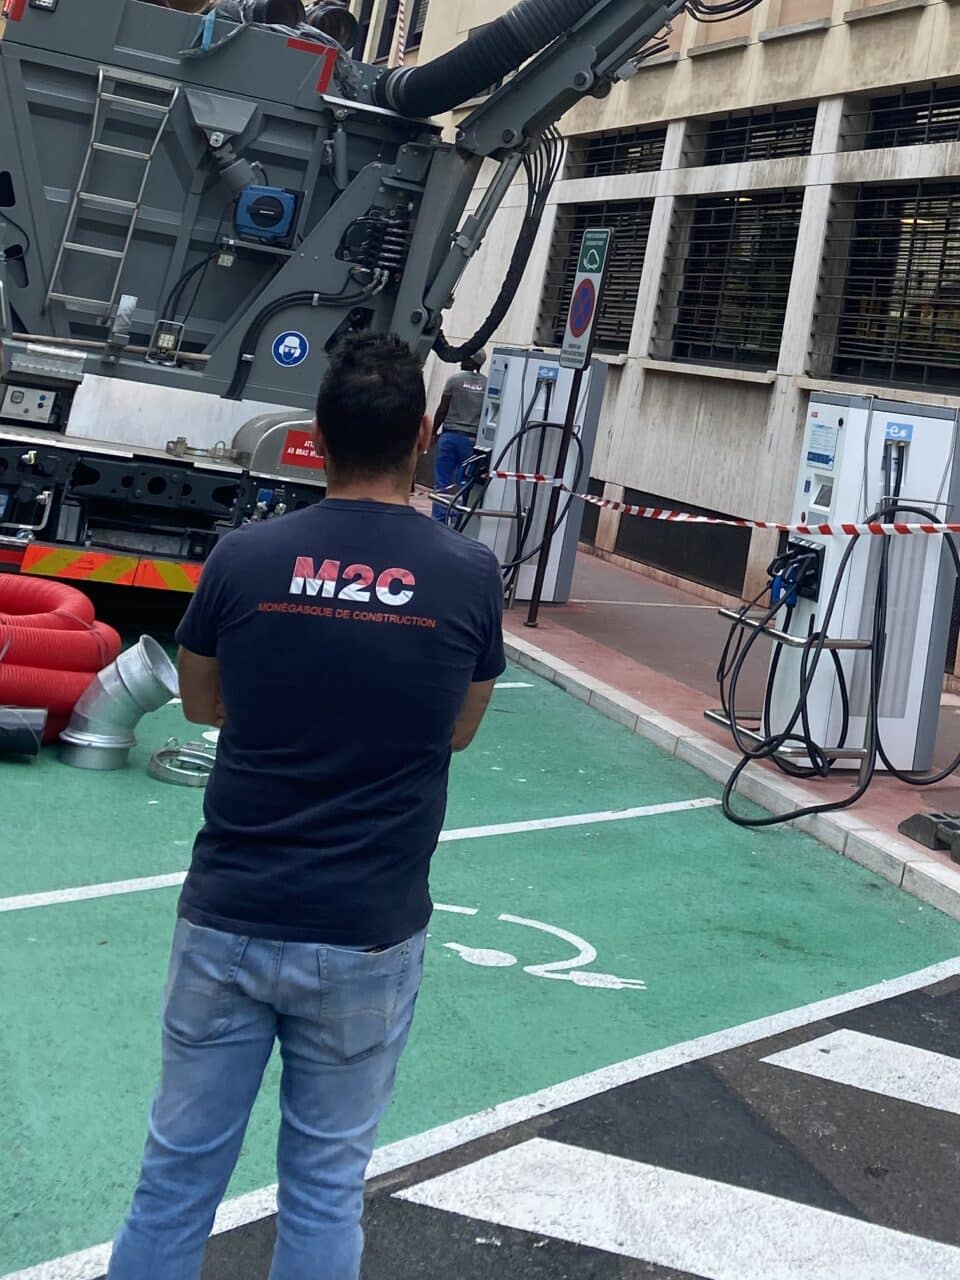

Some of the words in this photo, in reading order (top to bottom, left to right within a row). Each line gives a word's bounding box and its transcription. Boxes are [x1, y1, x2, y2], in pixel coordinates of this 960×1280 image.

[288, 555, 416, 607] M2C
[335, 608, 350, 619] DE
[352, 610, 437, 628] CONSTRUCTION
